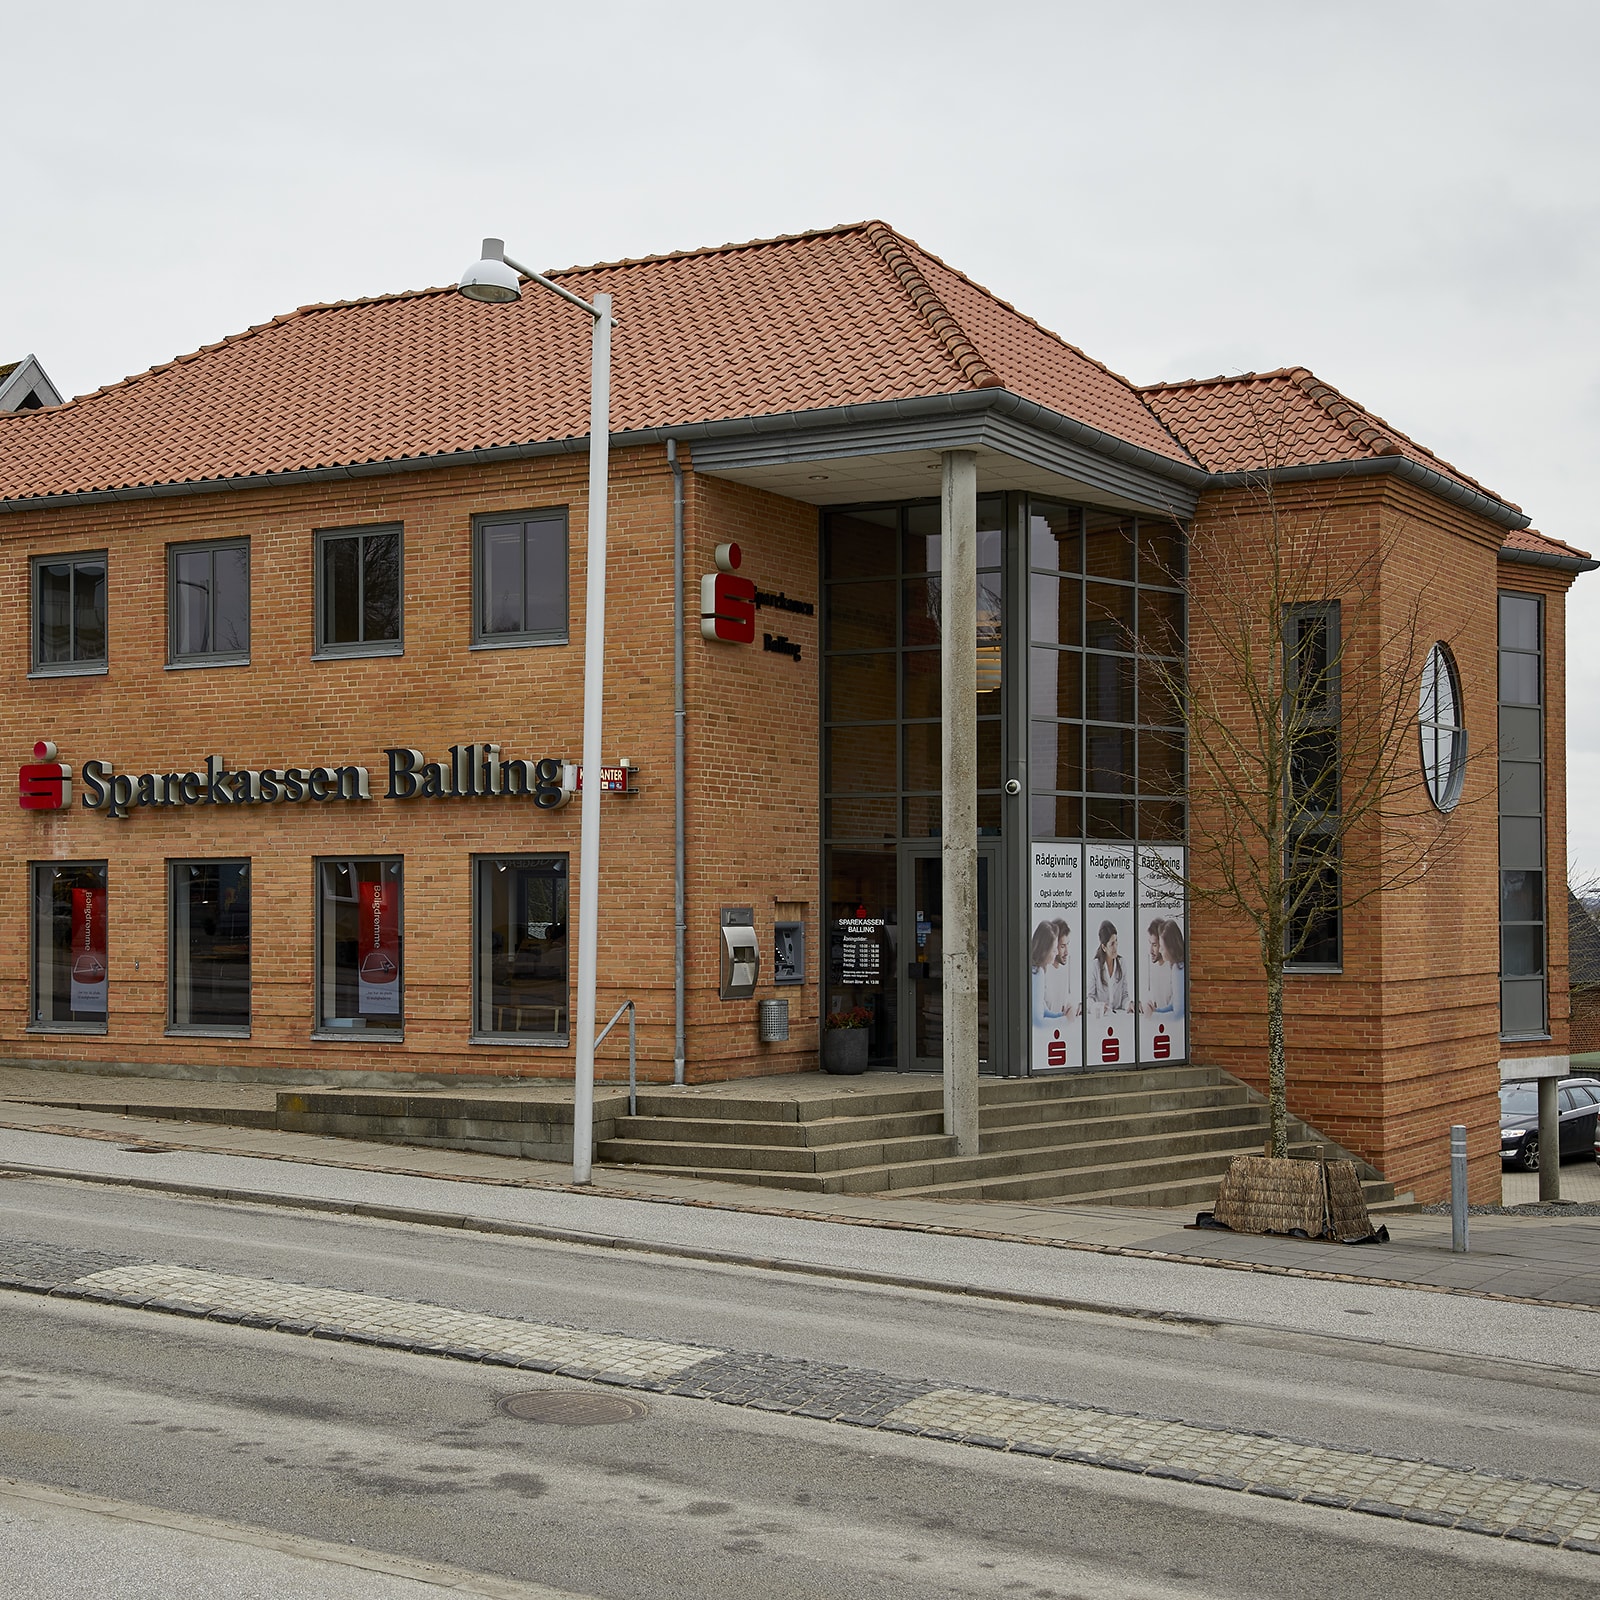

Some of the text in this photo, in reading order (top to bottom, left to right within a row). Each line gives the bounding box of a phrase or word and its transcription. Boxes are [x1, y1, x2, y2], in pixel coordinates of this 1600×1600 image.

[82, 755, 371, 818] Sparekassen
[384, 744, 570, 809] Balling
[1035, 853, 1078, 868] Rådgivning
[1089, 855, 1131, 869] Rådgivning
[1040, 889, 1051, 898] Også
[1052, 889, 1064, 897] uden
[1094, 890, 1105, 899] Også
[1106, 890, 1117, 898] uden
[1089, 901, 1104, 909] normal
[372, 885, 381, 949] Boligdrømme
